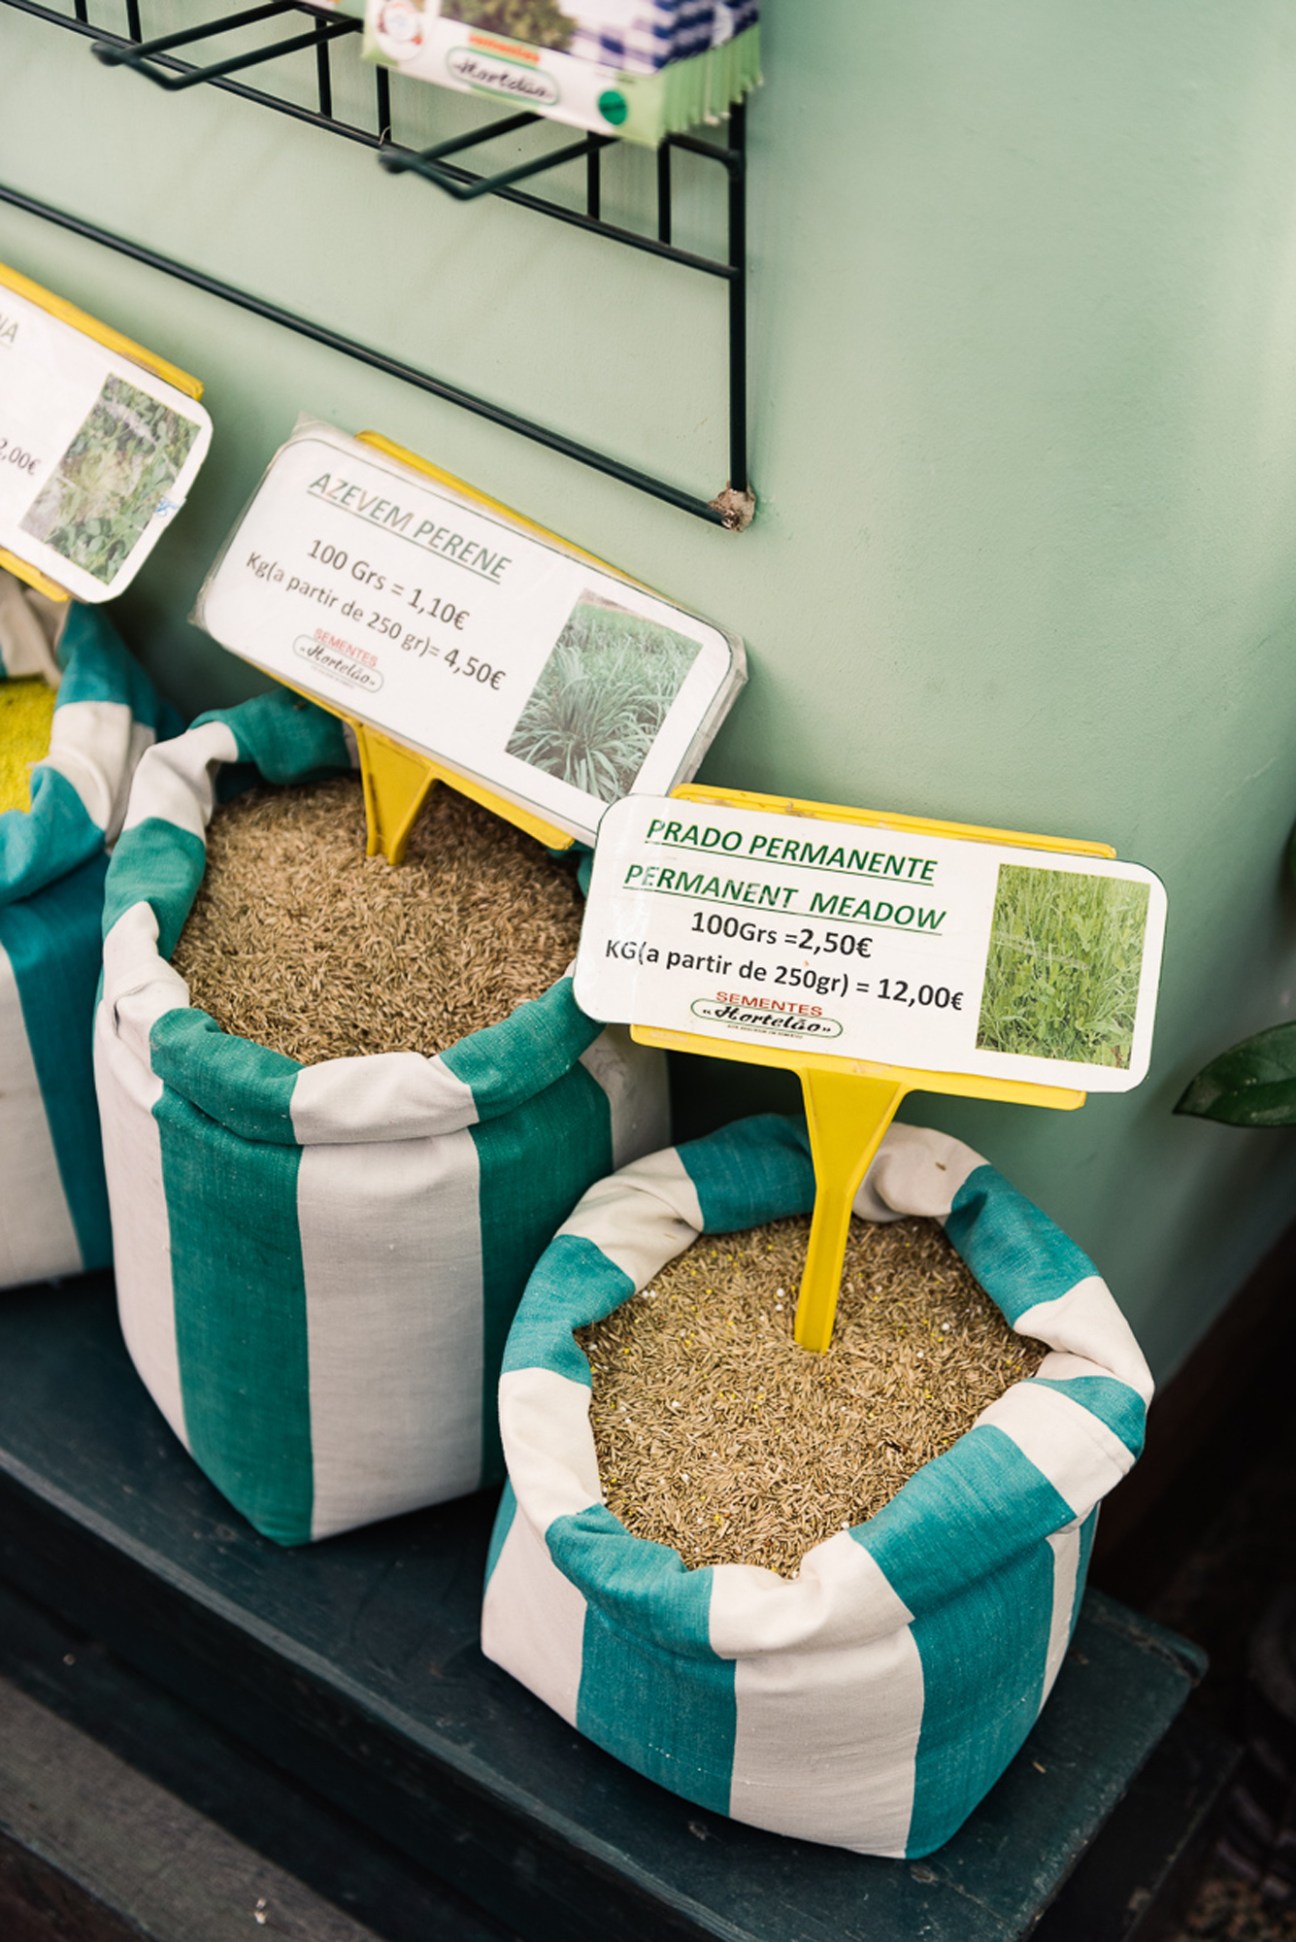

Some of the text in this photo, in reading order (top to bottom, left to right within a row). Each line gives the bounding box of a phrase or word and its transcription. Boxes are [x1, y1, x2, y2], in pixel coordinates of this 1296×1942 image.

[308, 472, 512, 579] AZEVEM PERENE
[307, 539, 470, 631] 100 Grs = 1,10€
[286, 576, 339, 608] partir
[341, 600, 364, 622] de
[367, 612, 402, 640] 250
[444, 648, 506, 690] 4,50€
[314, 628, 378, 668] SEMENTES
[646, 818, 938, 882] PRADO PERMANENTE
[624, 864, 947, 930] PERMANENT MEADOW
[691, 911, 777, 945] 100Grs
[666, 948, 732, 975] partir
[738, 960, 767, 982] de
[774, 966, 849, 998] 250gr)
[856, 981, 870, 994] =
[877, 978, 964, 1011] 12,00€
[716, 991, 823, 1017] SEMENTES
